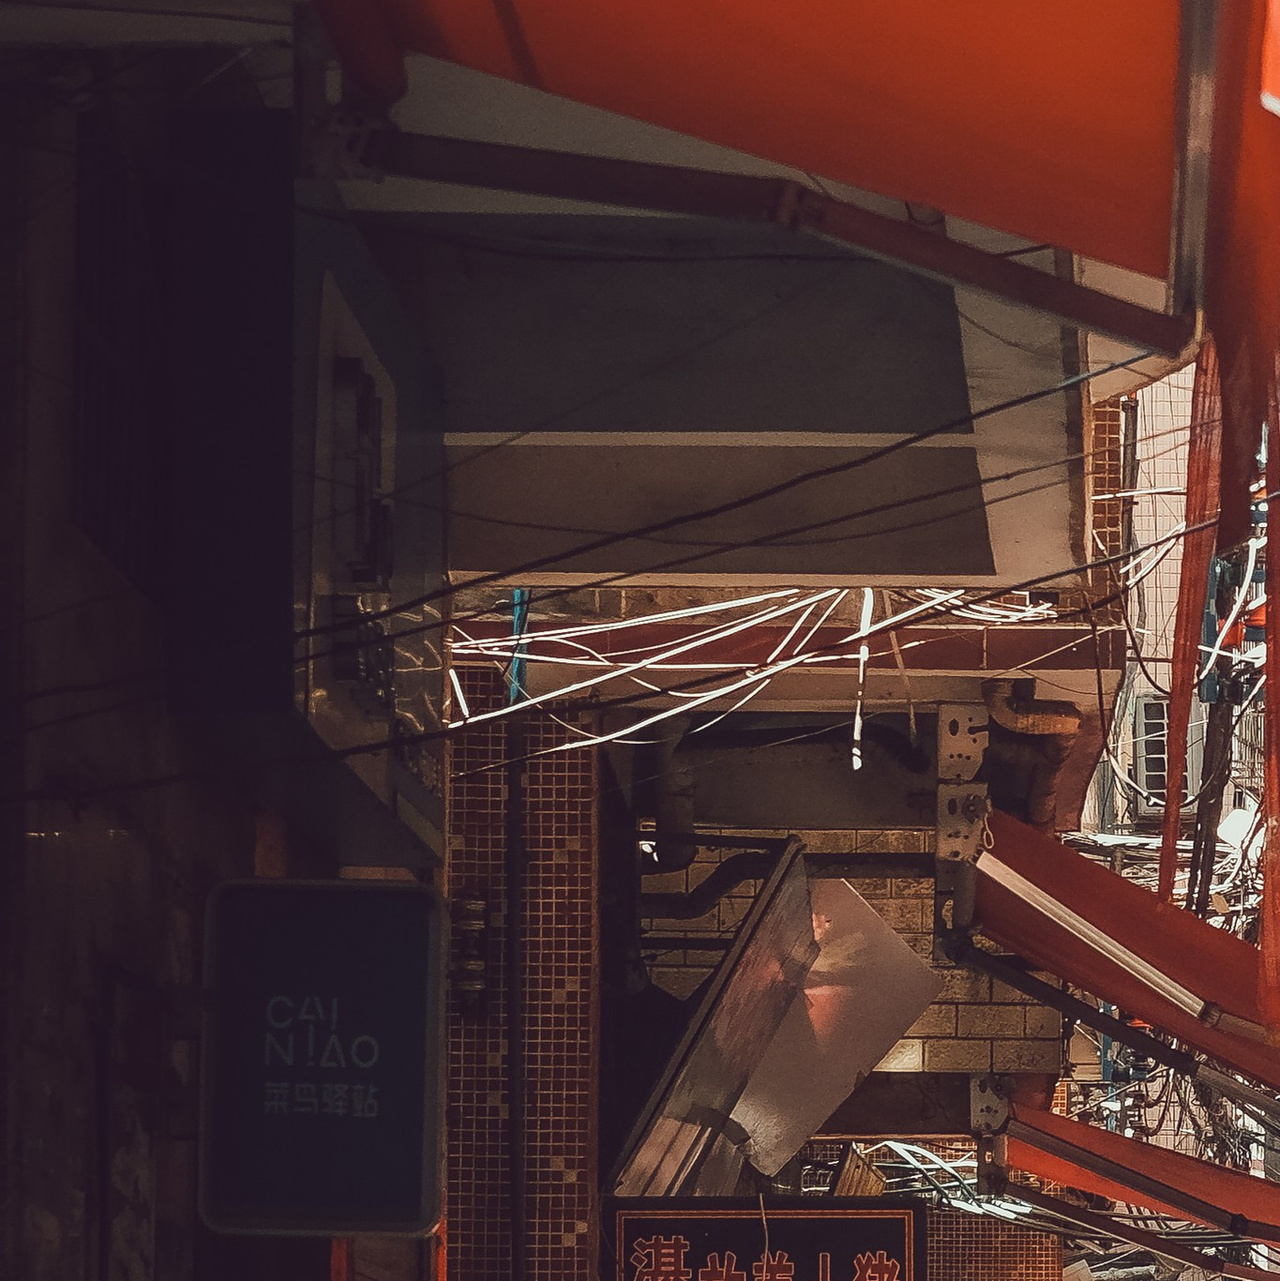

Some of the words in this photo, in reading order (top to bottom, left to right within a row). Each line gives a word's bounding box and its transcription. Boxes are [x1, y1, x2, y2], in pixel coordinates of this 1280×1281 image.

[266, 996, 339, 1029] CAI
[263, 1081, 380, 1118] 菜鸟驿站
